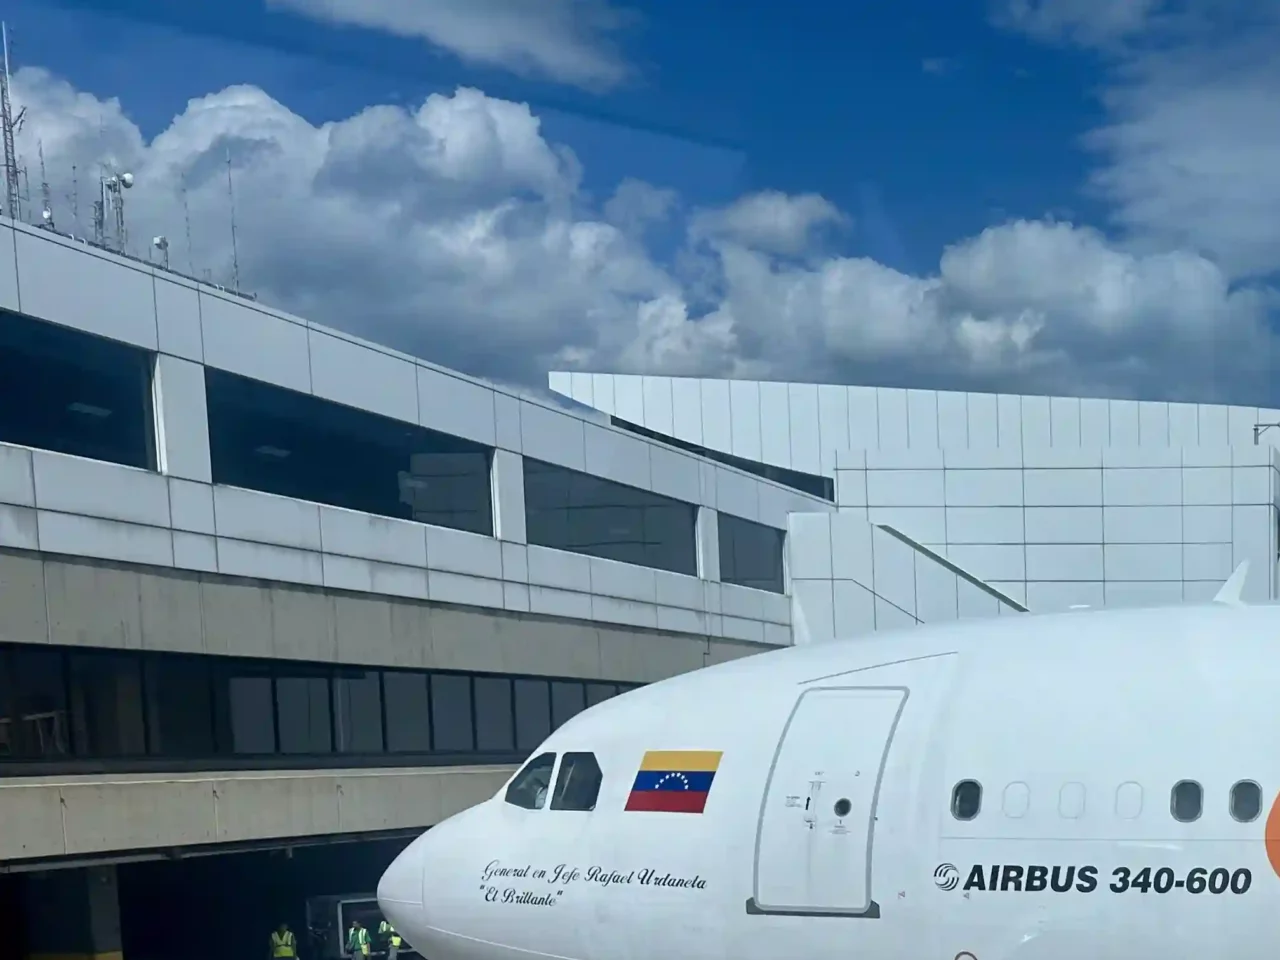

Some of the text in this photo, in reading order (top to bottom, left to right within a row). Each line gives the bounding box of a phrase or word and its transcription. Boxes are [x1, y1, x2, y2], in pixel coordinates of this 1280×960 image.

[481, 859, 708, 889] General en Jefe Rafael Urdaneta
[963, 865, 1252, 894] AIRBUS 340-600
